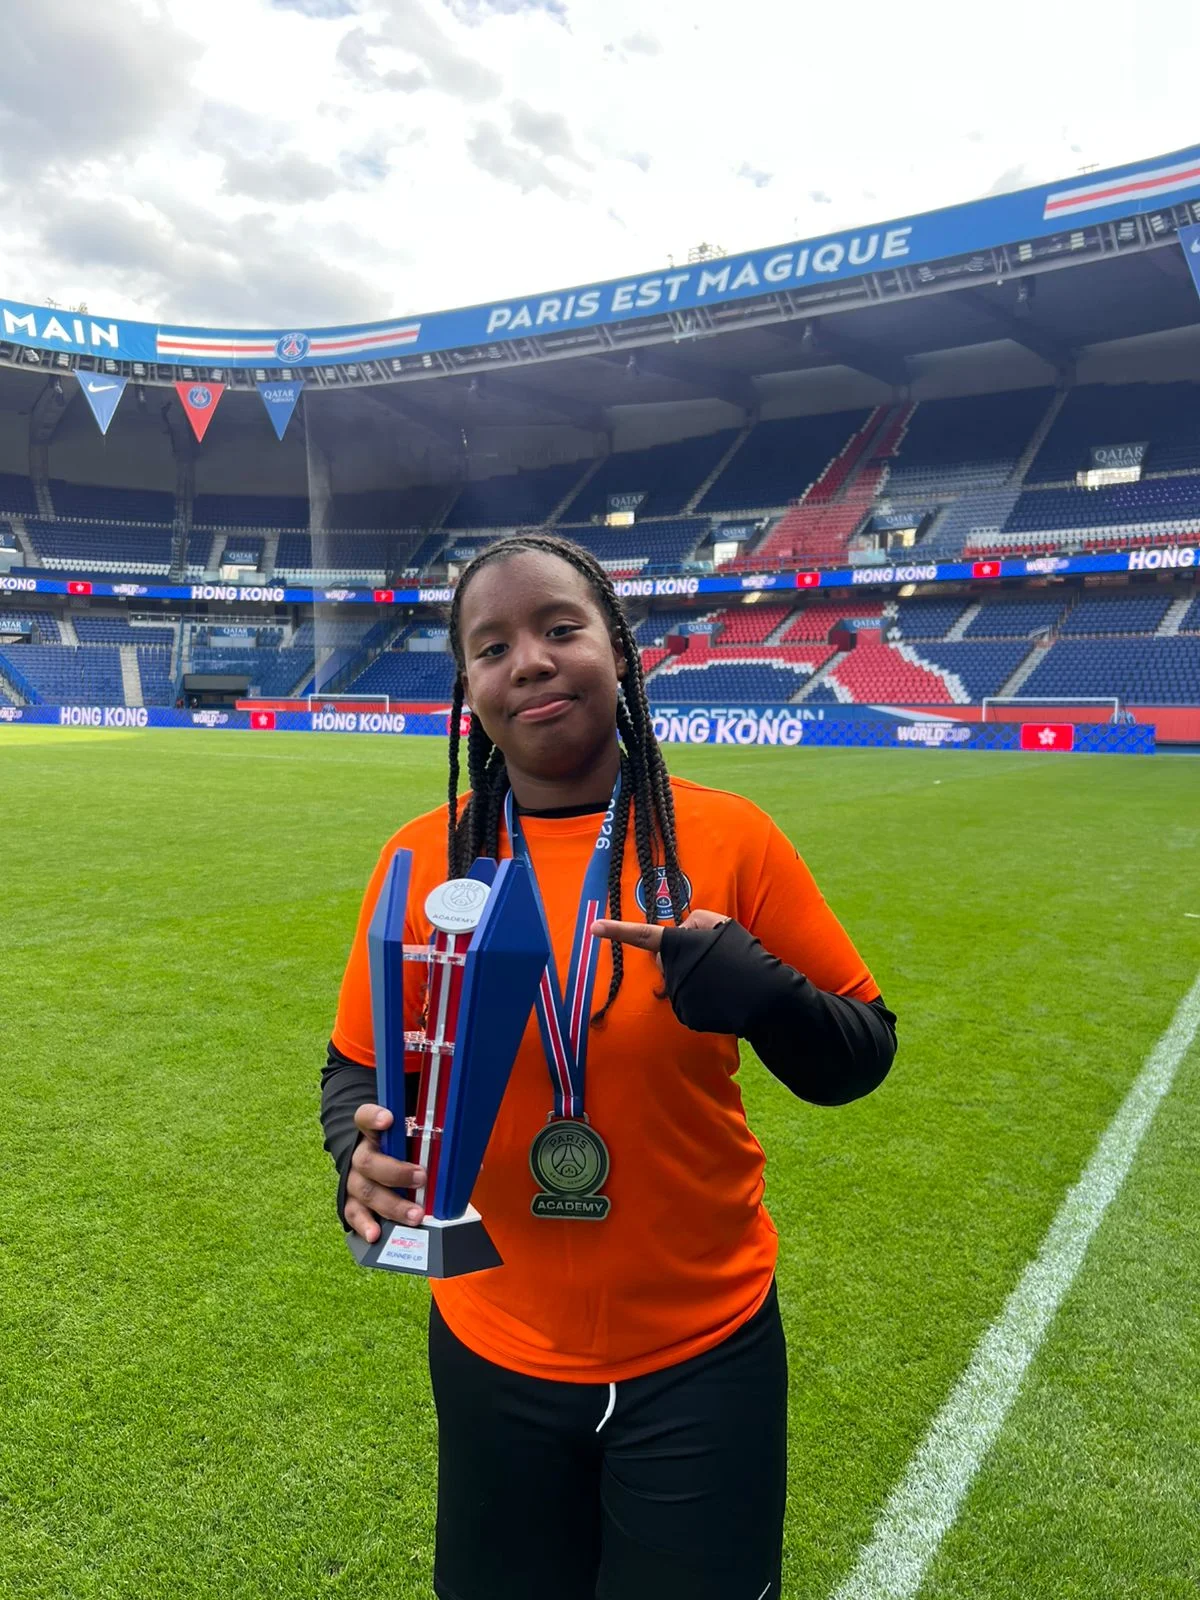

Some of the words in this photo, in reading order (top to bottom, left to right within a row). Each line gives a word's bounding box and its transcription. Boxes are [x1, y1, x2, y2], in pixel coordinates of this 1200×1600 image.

[487, 291, 600, 333] PARIS
[611, 273, 690, 312] EST
[697, 227, 912, 296] MAGIQUE
[3, 308, 119, 348] MAIN
[264, 389, 294, 401] QATAR
[1095, 446, 1143, 463] QATAR
[1129, 548, 1195, 570] HONG
[852, 569, 893, 583] HONG
[895, 566, 938, 581] KONG
[0, 578, 36, 591] KONG
[613, 580, 653, 597] HONG
[655, 577, 699, 595] KONG
[192, 586, 237, 600] HONG
[240, 587, 285, 602] KONG
[420, 589, 450, 601] HONG
[0, 621, 21, 629] ATAR
[688, 623, 712, 632] QATAR
[853, 620, 881, 628] QATAR
[60, 706, 102, 725] HONG
[104, 707, 148, 727] KONG
[312, 712, 357, 730] HONG
[360, 713, 405, 732] KONG
[652, 716, 710, 743] ONG
[715, 717, 803, 746] KONG
[432, 914, 475, 923] ACADEMY
[549, 1134, 588, 1149] PARIS
[537, 1201, 604, 1212] ACADEMY
